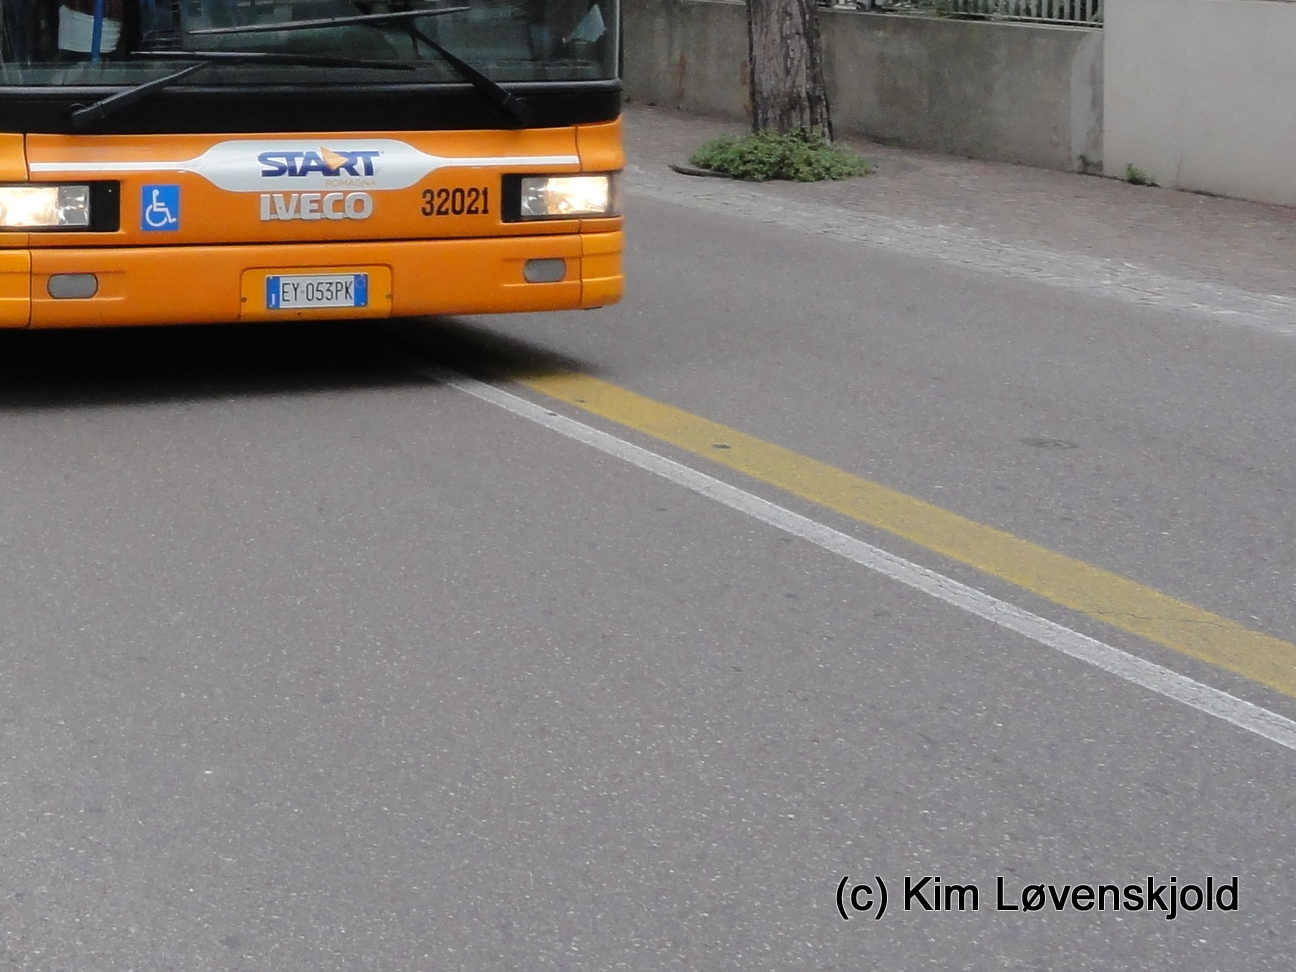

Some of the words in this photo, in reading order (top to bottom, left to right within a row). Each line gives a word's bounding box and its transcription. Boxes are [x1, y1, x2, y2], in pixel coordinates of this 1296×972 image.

[257, 149, 381, 178] START
[325, 178, 377, 187] ROMAGNA
[260, 192, 374, 221] IVECO
[421, 186, 489, 217] 32021
